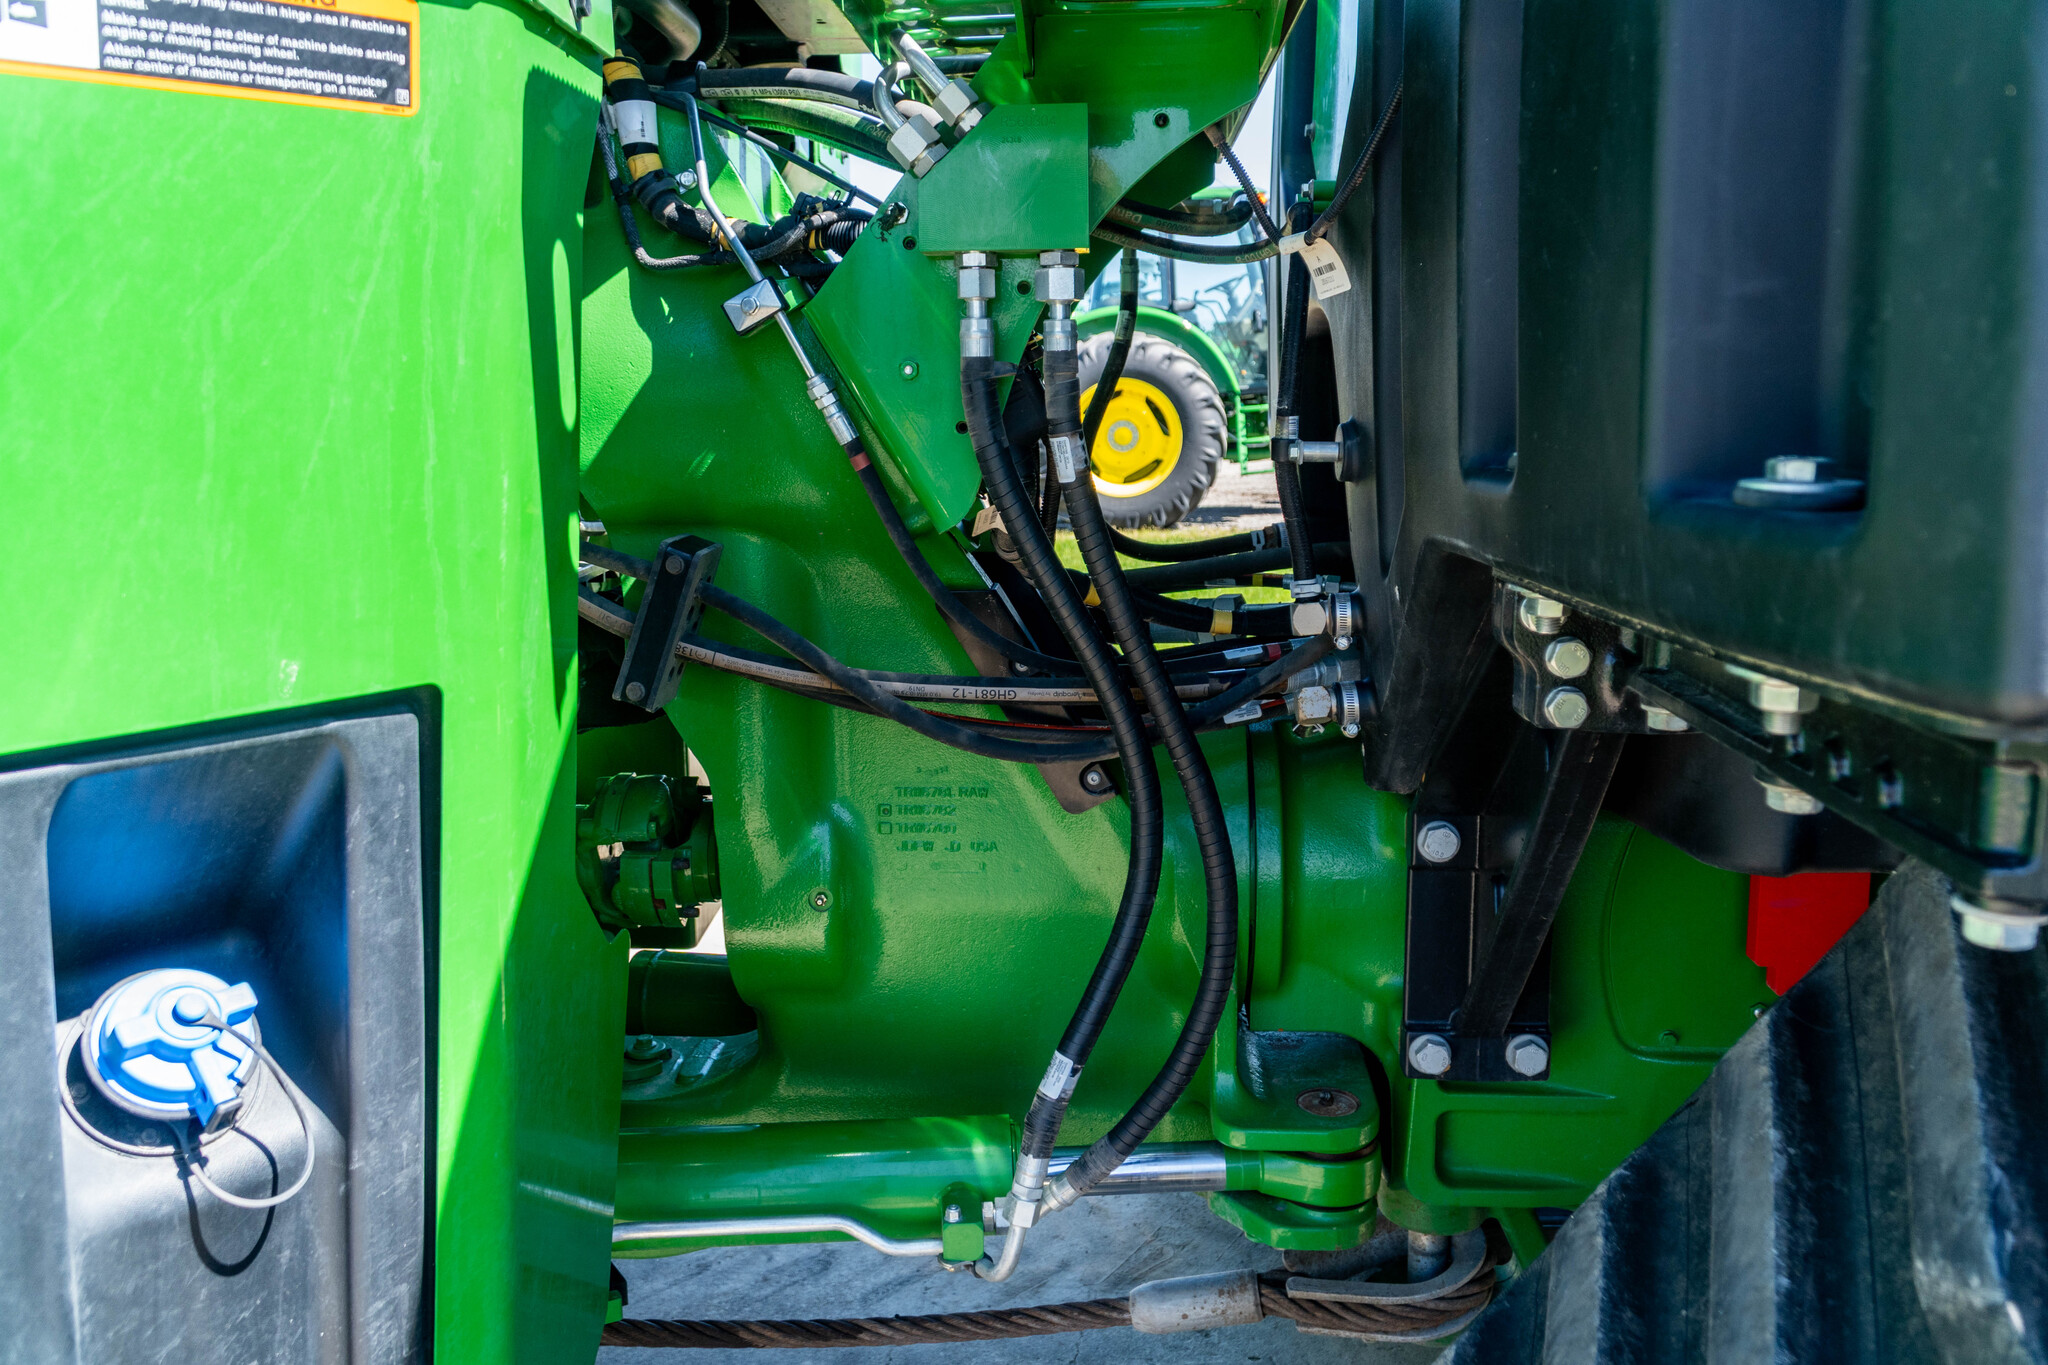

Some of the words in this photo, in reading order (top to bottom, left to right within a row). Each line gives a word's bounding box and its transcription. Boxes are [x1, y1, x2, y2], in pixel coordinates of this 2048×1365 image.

[101, 9, 138, 27] Make
[138, 16, 168, 31] sure
[169, 20, 212, 37] people
[212, 27, 233, 40] are
[234, 28, 264, 44] clear
[265, 34, 279, 45] of
[280, 36, 327, 52] machine
[328, 42, 363, 58] before
[365, 48, 406, 66] starting
[228, 1, 265, 15] result
[265, 4, 278, 17] in
[279, 6, 312, 23] hinge
[313, 13, 338, 26] area
[340, 15, 349, 27] if
[350, 18, 395, 34] machine
[396, 24, 407, 37] is
[101, 24, 148, 41] engine
[148, 31, 164, 43] or
[164, 32, 211, 52] moving
[212, 39, 261, 58] steering
[263, 45, 300, 61] wheel.
[103, 40, 145, 58] Attach
[146, 47, 196, 67] steering
[197, 52, 247, 71] lockouts
[248, 60, 284, 75] before
[285, 65, 343, 85] performing
[345, 73, 388, 88] services
[103, 55, 134, 70] near
[134, 59, 174, 75] center
[174, 64, 190, 76] of
[190, 65, 239, 82] machine
[240, 72, 254, 84] or
[255, 74, 322, 94] transporting
[323, 82, 337, 94] on
[339, 85, 346, 95] a
[347, 84, 377, 98] truck.
[952, 687, 1017, 700] GH681-12
